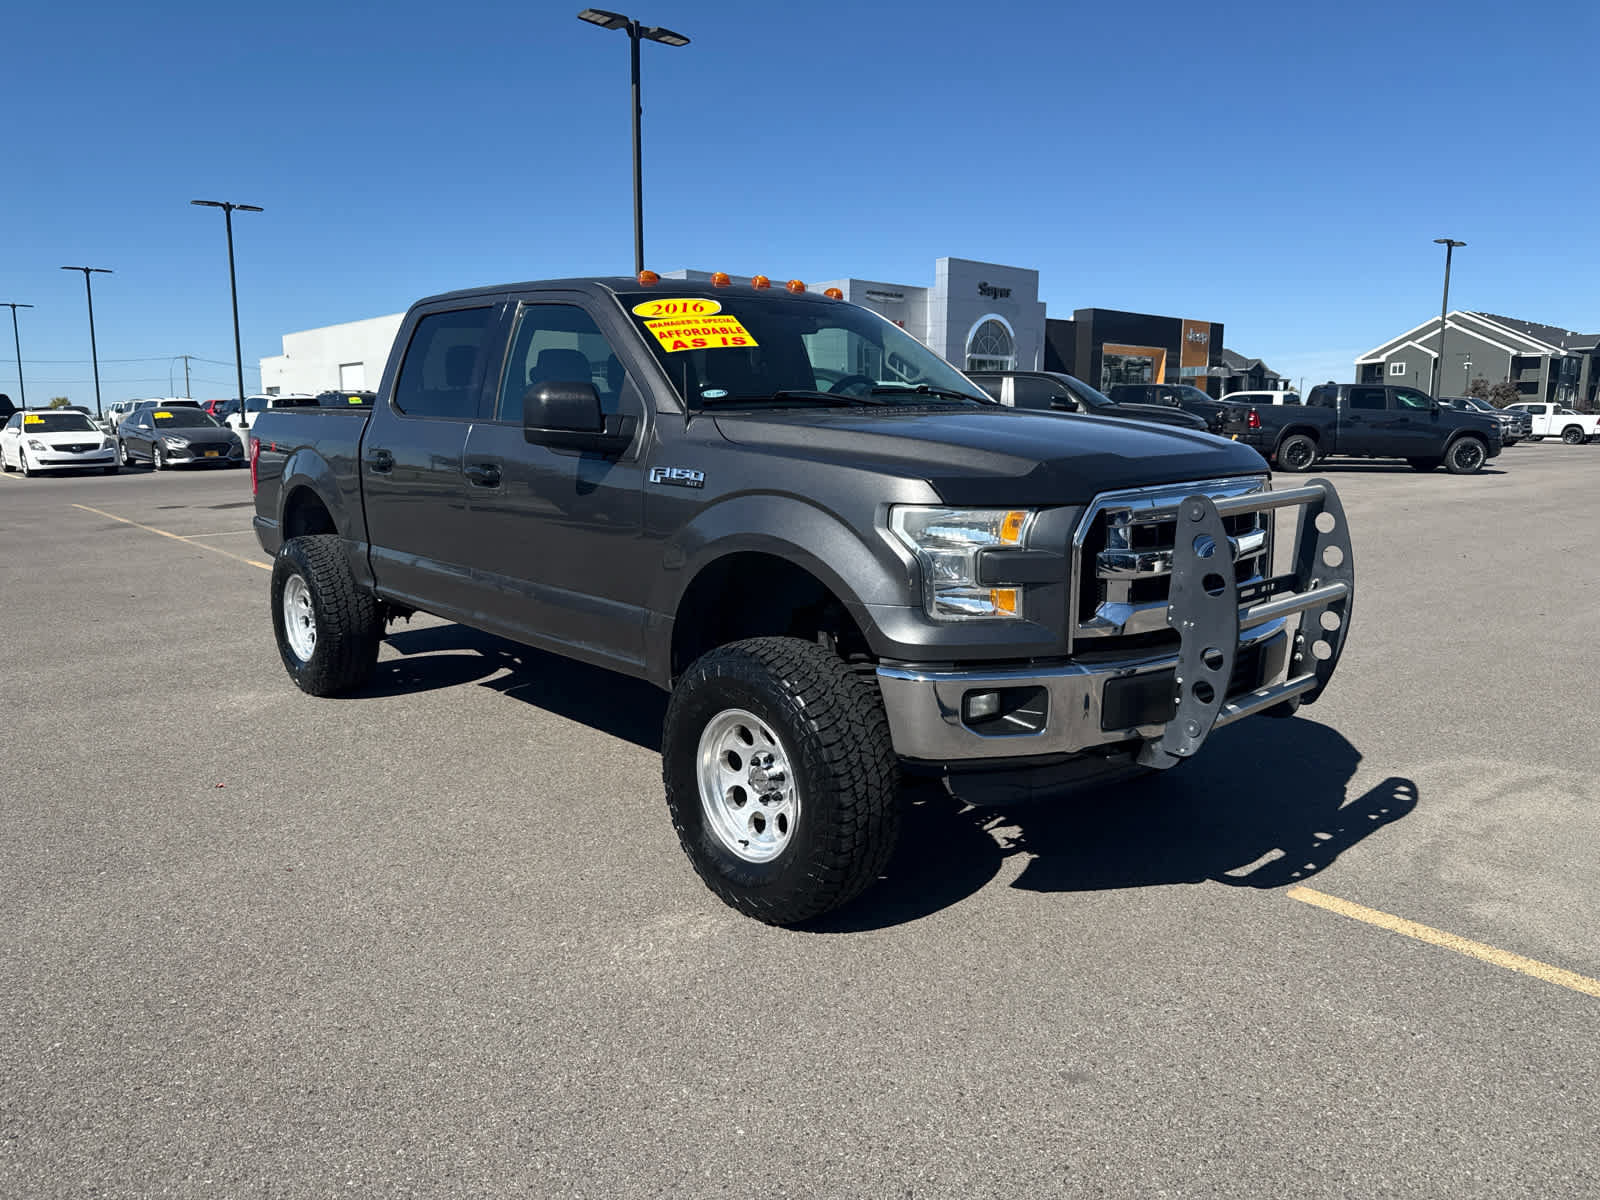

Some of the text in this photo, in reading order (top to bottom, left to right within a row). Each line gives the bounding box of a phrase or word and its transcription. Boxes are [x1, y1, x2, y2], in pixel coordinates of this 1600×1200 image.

[651, 302, 705, 316] 2016
[649, 317, 737, 329] MANAGER'S SPECIAL
[658, 326, 744, 340] AFFORDABLE
[672, 336, 747, 351] AS IS
